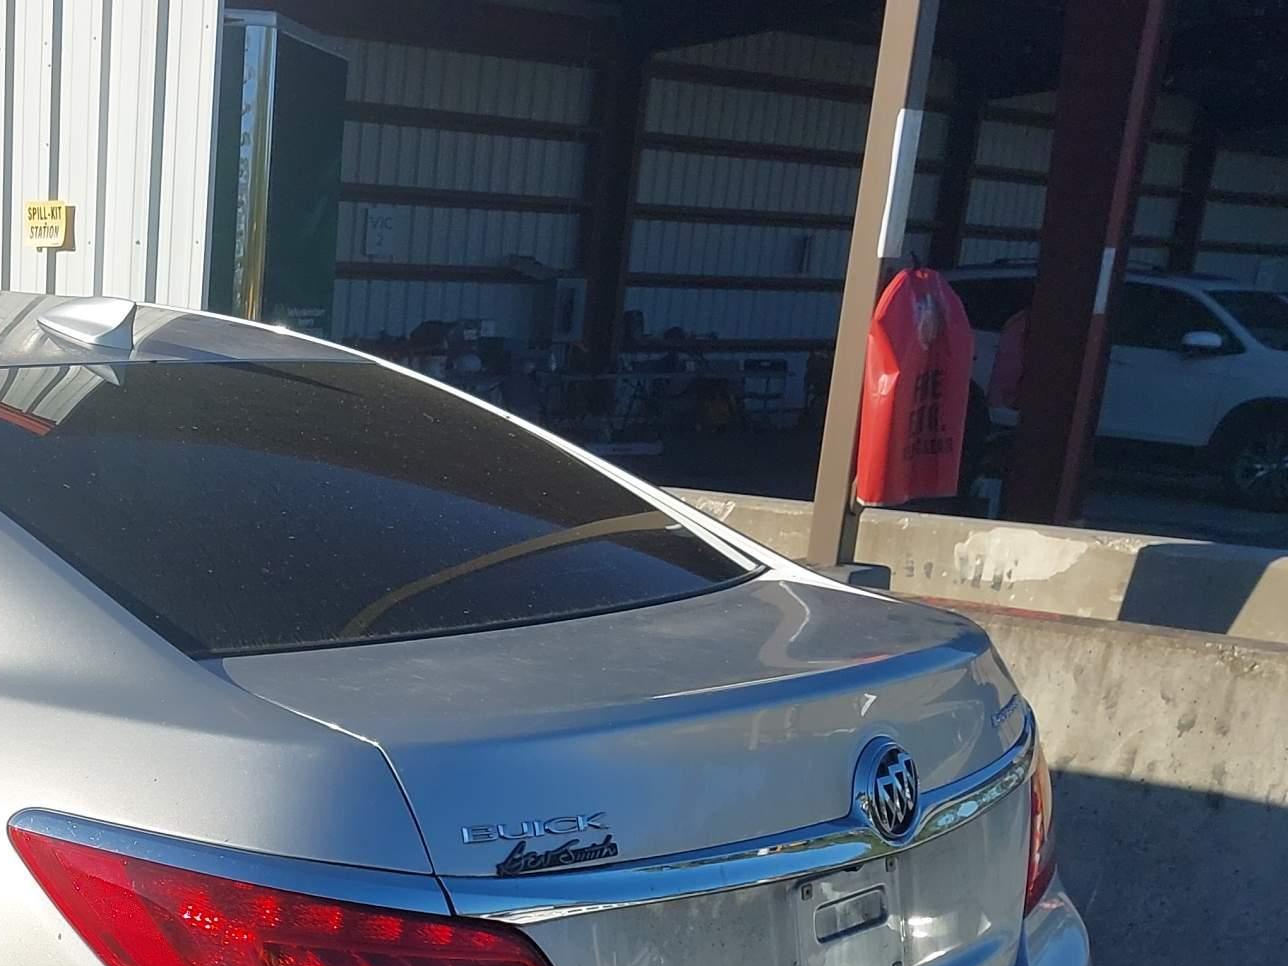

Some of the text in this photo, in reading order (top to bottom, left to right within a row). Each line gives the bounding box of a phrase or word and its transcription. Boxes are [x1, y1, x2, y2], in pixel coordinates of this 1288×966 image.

[28, 206, 62, 221] SPILL-KIT
[29, 225, 60, 240] STATION
[461, 812, 610, 844] BUICK
